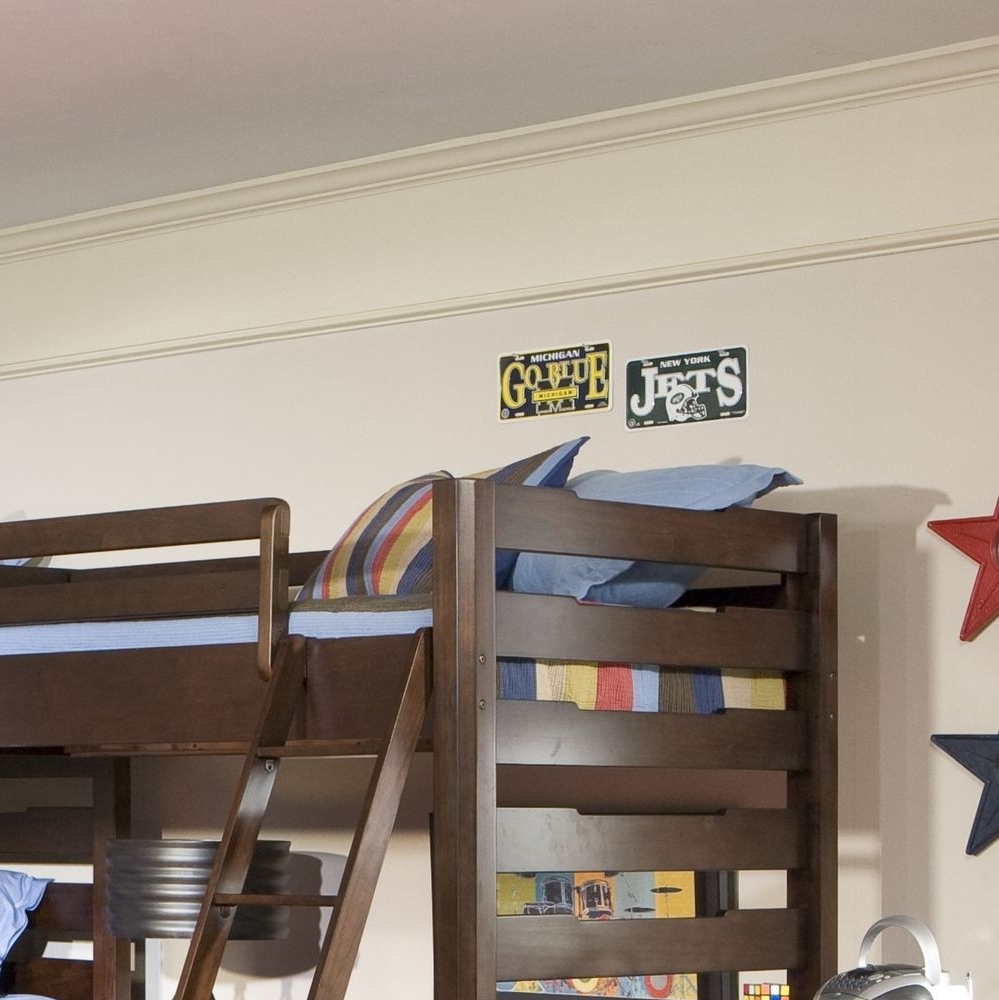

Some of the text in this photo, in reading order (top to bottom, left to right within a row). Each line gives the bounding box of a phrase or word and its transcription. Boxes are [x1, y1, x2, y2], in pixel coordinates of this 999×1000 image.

[530, 349, 580, 363] MICHIGAN
[660, 355, 711, 368] NEW YORK
[502, 351, 608, 409] GO BLUE
[630, 357, 743, 416] JETS
[538, 390, 573, 399] MICHIGAN
